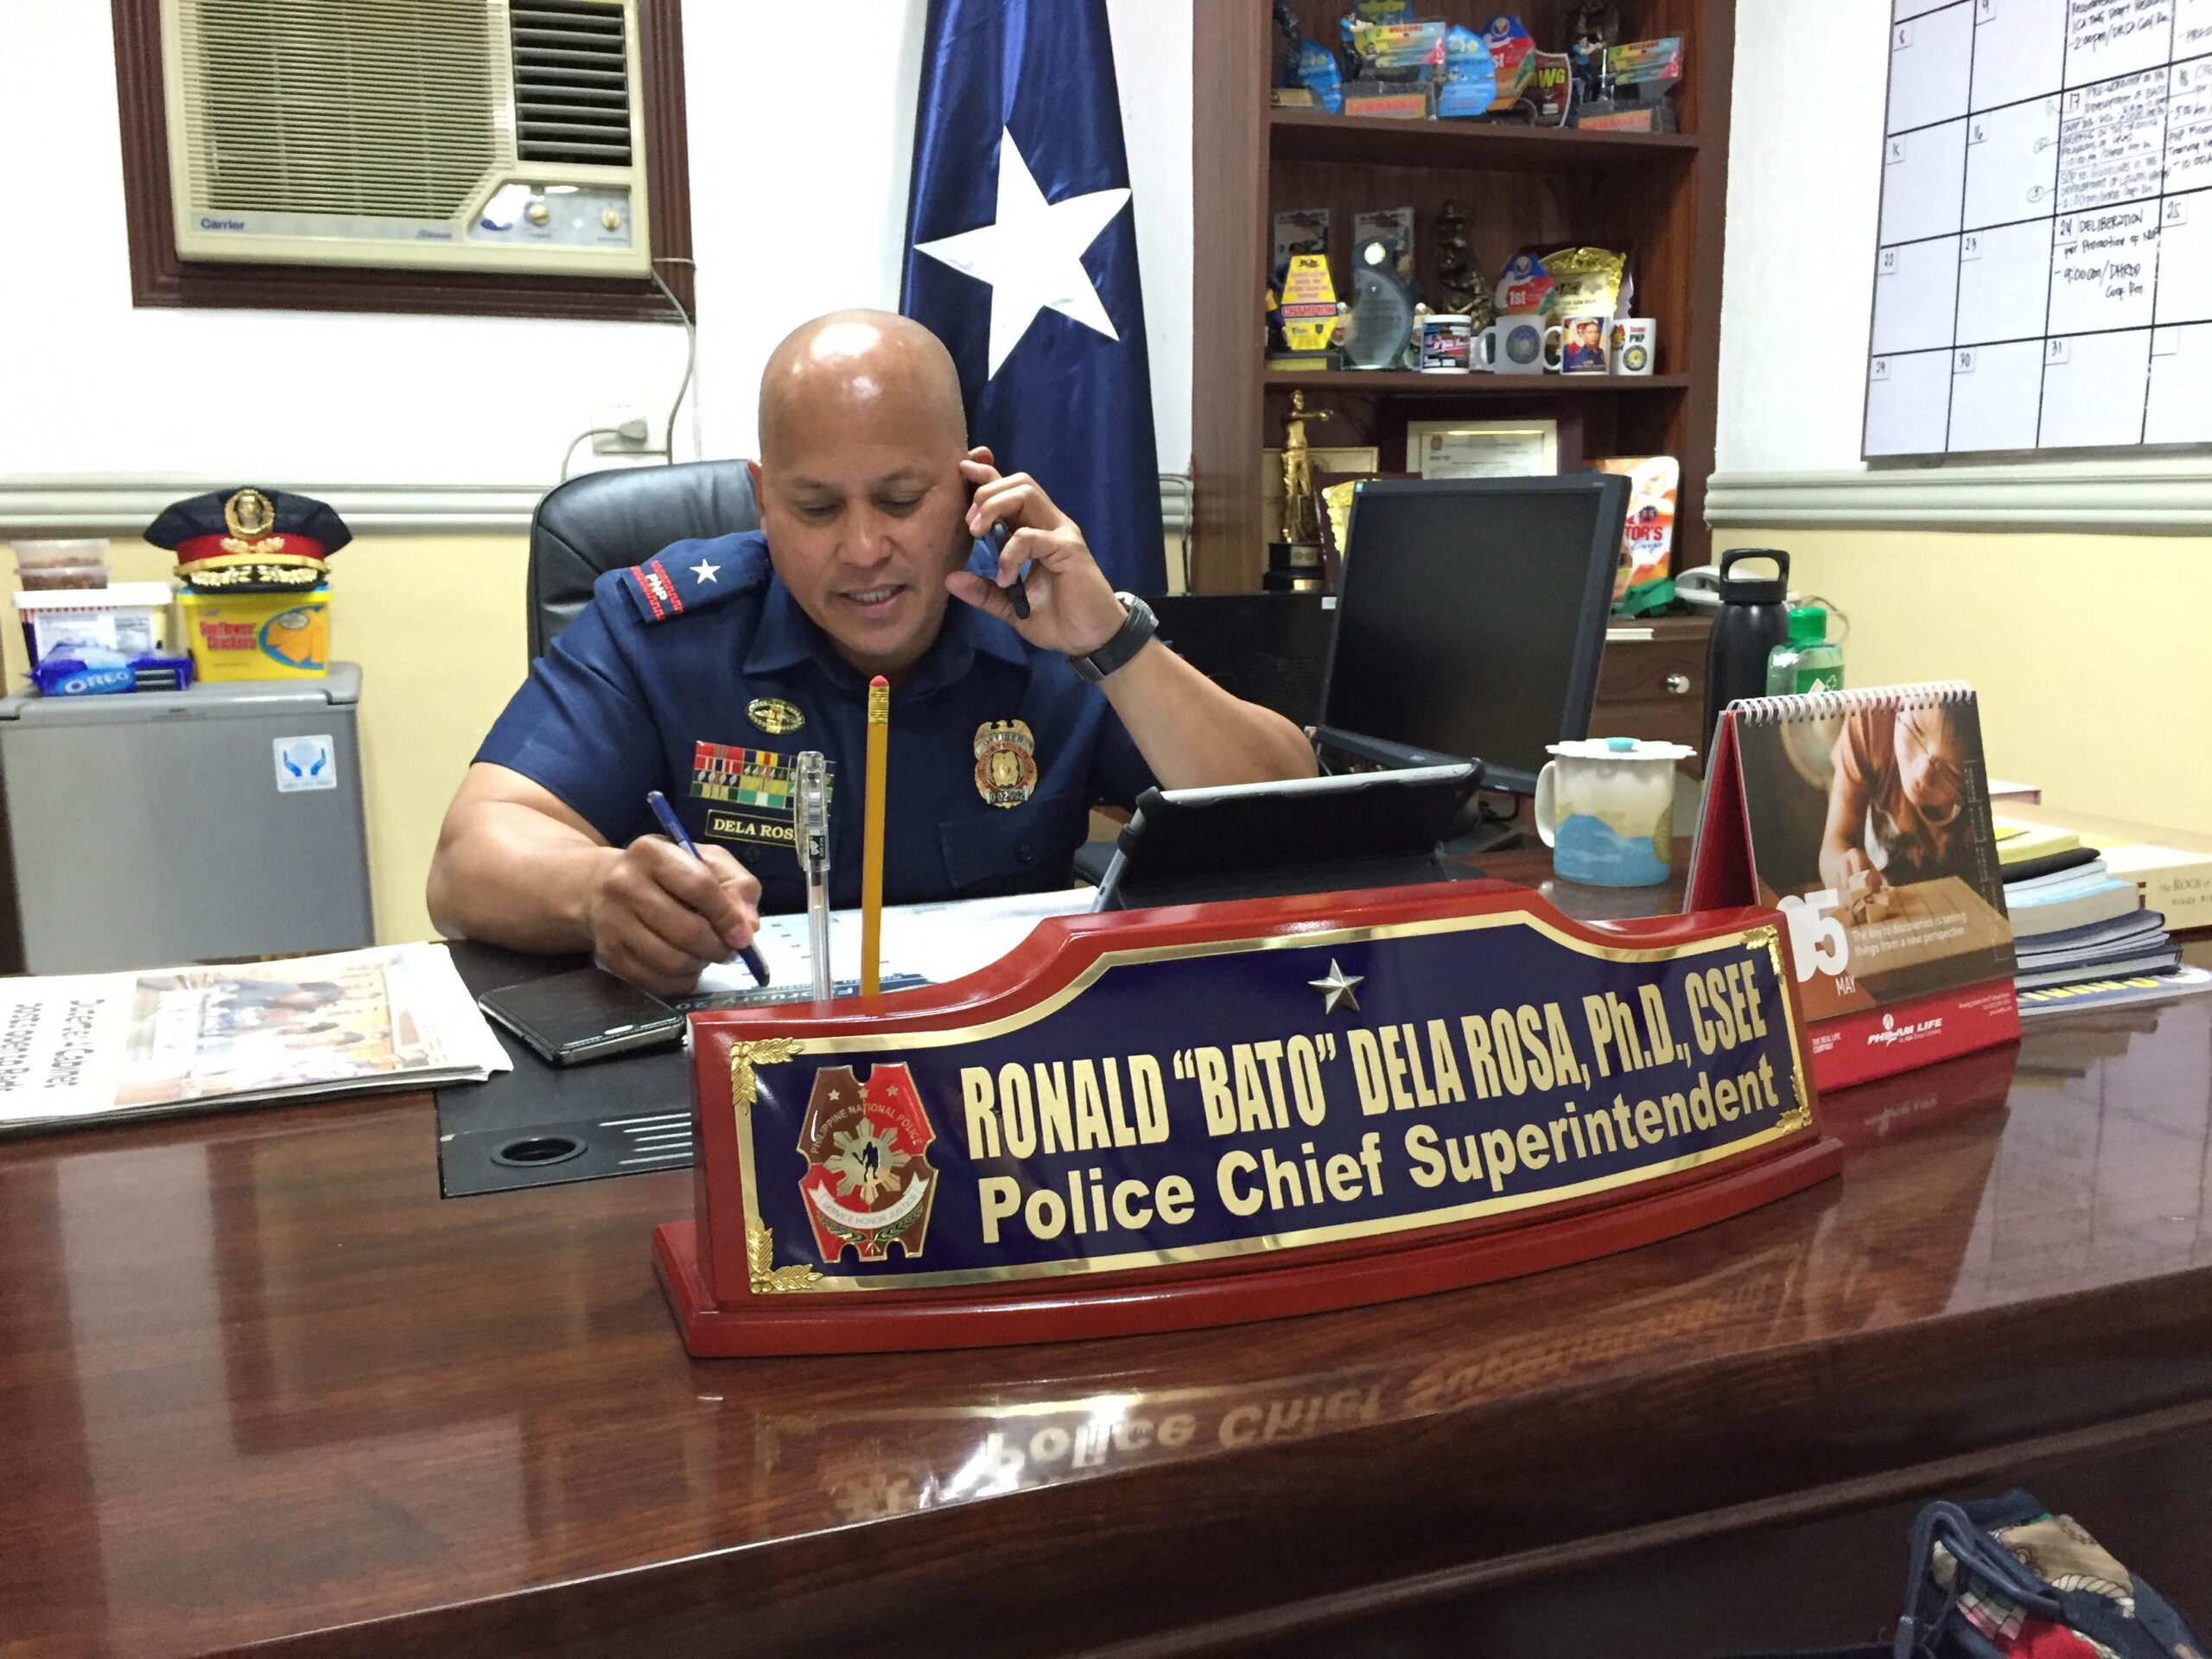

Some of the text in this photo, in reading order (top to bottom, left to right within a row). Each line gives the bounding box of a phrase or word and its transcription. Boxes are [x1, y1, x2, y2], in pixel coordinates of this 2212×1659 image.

[200, 216, 246, 232] Carrier
[1283, 304, 1335, 318] CHAMPION
[645, 573, 668, 601] PNP
[65, 671, 130, 694] OREO
[983, 732, 1024, 746] OFFICER
[714, 817, 796, 841] DELA ROS
[2173, 878, 2202, 891] ROCK
[1835, 975, 1857, 996] MAY
[1917, 1018, 1943, 1033] LIFE
[43, 1048, 95, 1088] Cabinet
[960, 1053, 1170, 1160] RONALD
[1347, 1018, 1467, 1116] DELA
[1461, 1001, 1592, 1100] ROSA,
[1582, 983, 1693, 1077] Ph.D.,
[1684, 958, 1768, 1056] CSEE
[810, 1103, 923, 1154] PHILIPPINE NATIONAL POLICE
[977, 1052, 1779, 1245] Police Chief Superintendent
